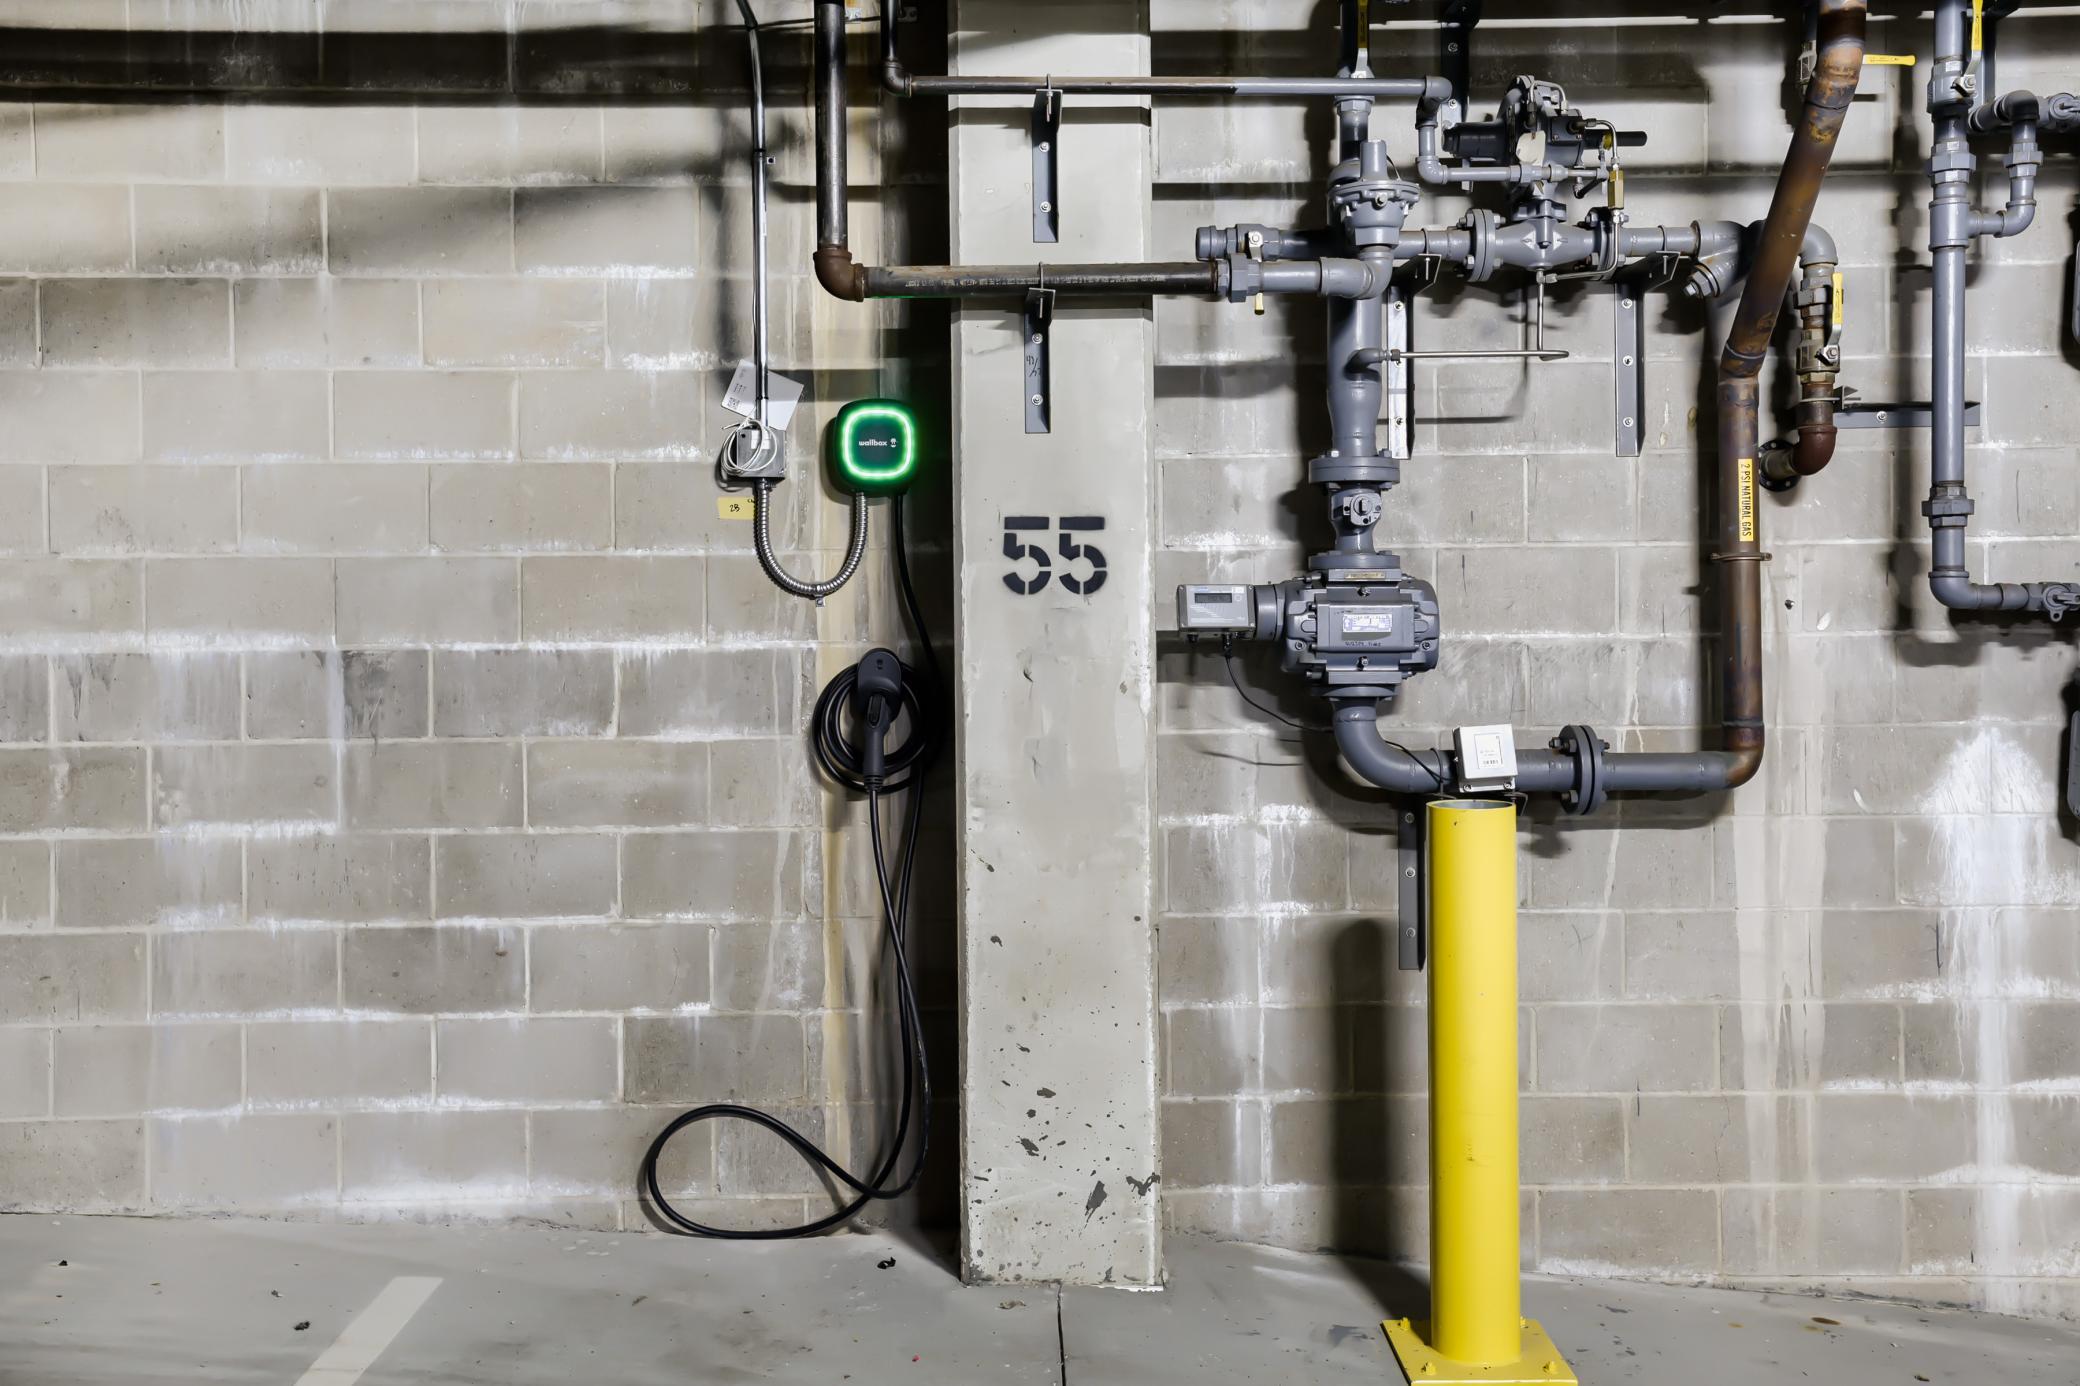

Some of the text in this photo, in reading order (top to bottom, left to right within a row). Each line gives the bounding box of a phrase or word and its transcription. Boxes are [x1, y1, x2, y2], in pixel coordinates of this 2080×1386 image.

[858, 438, 888, 447] wallbox
[1741, 471, 1751, 483] PSI
[1741, 486, 1751, 520] NATURAL
[1742, 521, 1752, 537] GAS
[1002, 516, 1107, 596] 55
